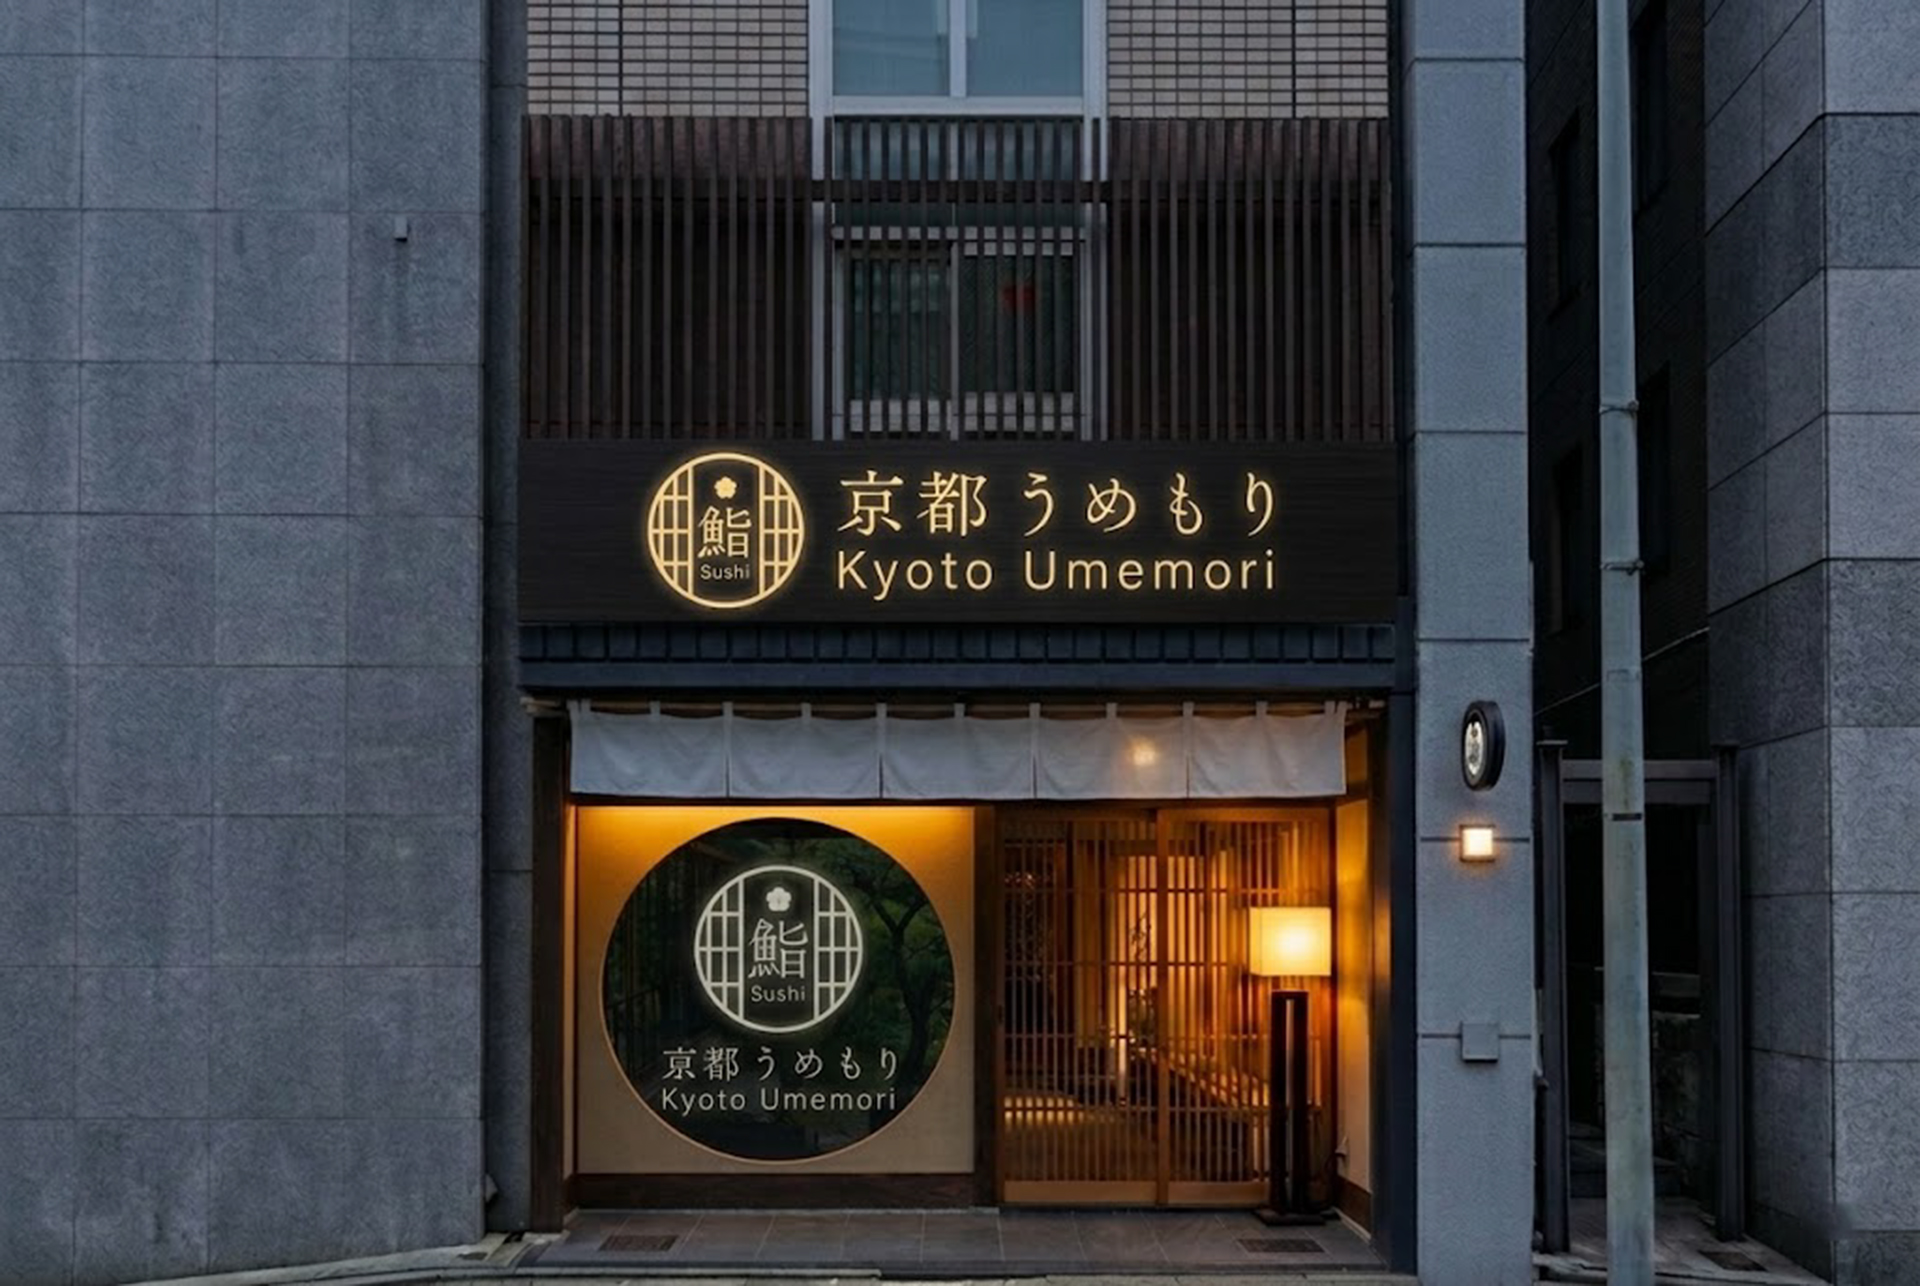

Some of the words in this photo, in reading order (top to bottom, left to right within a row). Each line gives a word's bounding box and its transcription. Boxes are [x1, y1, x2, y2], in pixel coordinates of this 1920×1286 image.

[837, 469, 1274, 537] 京都うめもり
[698, 505, 752, 558] 鮨
[700, 563, 750, 580] Sushi
[838, 550, 993, 600] Kyoto
[1025, 549, 1274, 590] Umemori
[748, 918, 809, 979] 鮨
[751, 984, 806, 1002] Sushi
[661, 1087, 747, 1117] Kyoto
[760, 1087, 896, 1112] Umemori
